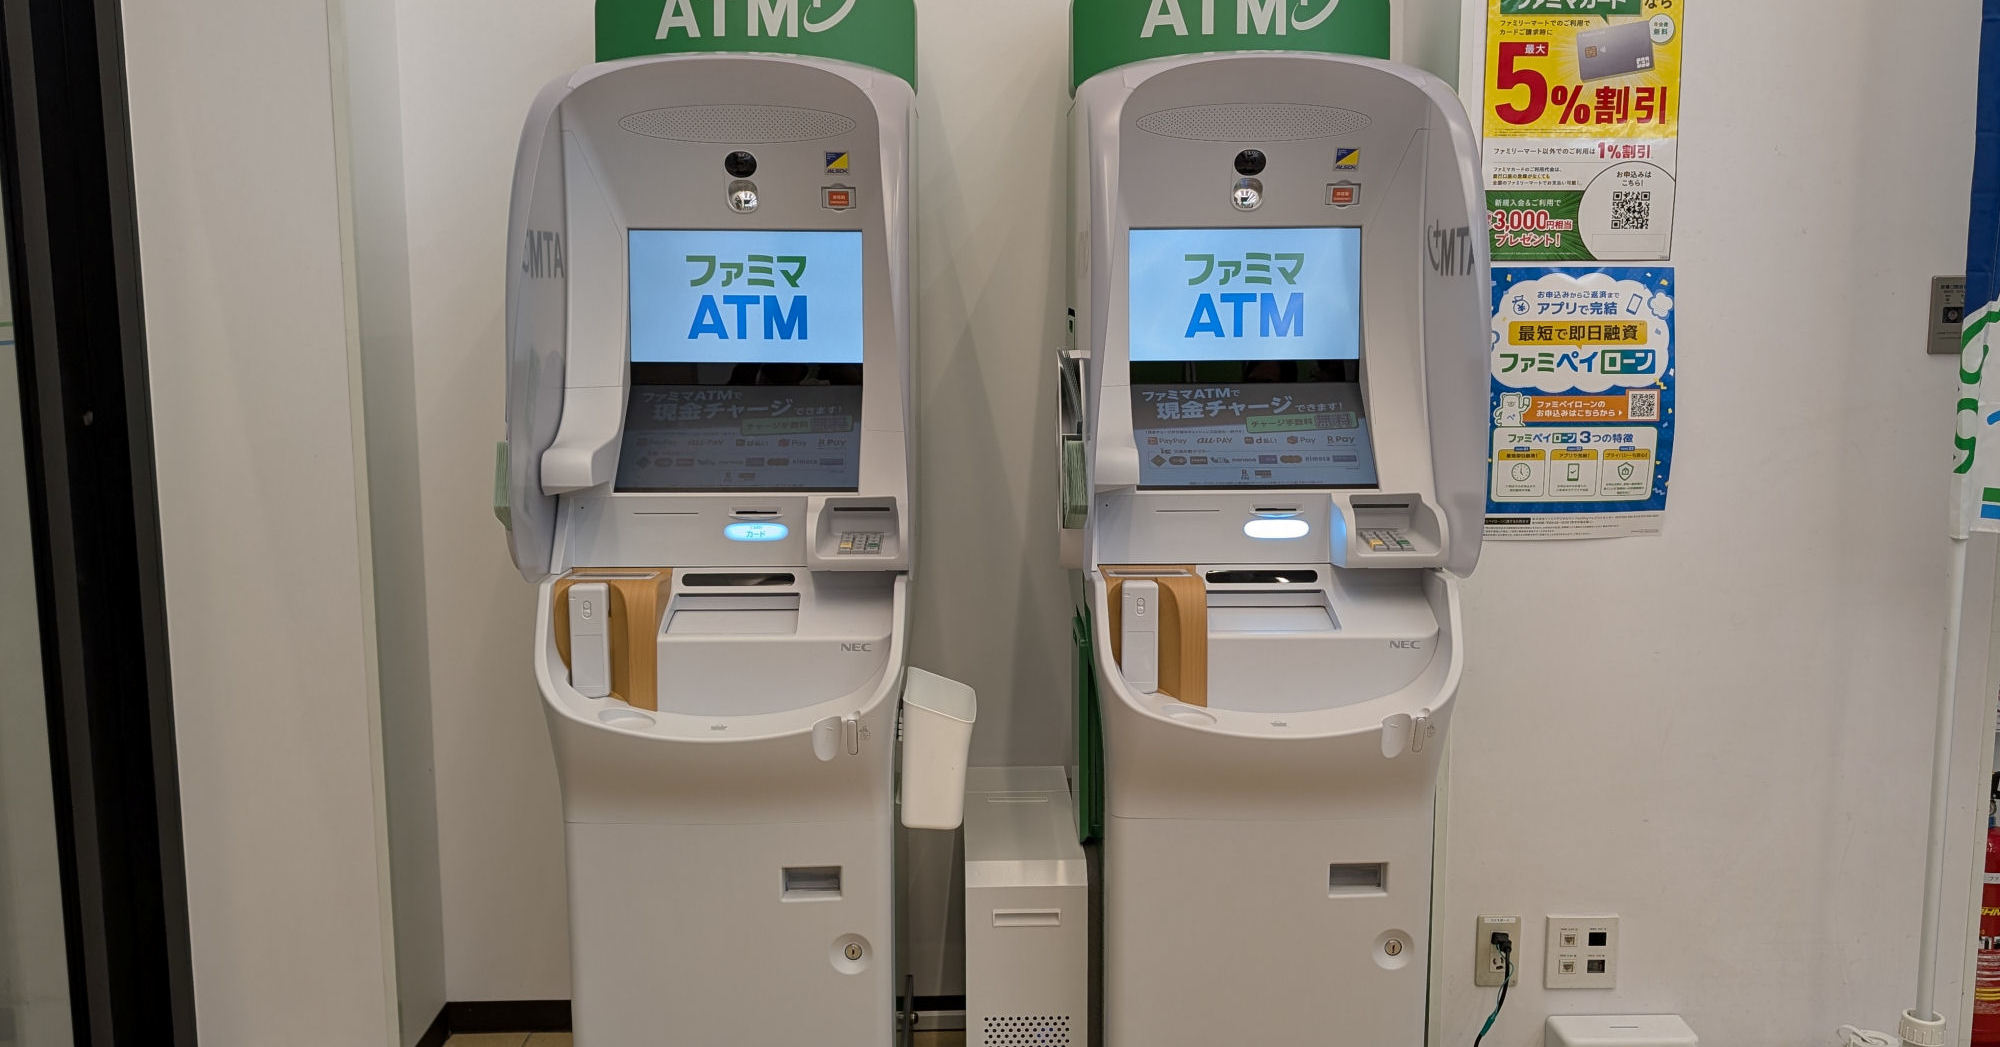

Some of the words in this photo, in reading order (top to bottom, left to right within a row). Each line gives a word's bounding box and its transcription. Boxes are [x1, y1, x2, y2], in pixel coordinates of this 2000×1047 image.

[1525, 44, 1546, 54] 最大
[1598, 141, 1651, 159] 1%割引
[1616, 171, 1651, 179] お申込みは
[1493, 209, 1573, 232] 3,000円相当
[1496, 233, 1561, 247] プレゼント!
[686, 254, 807, 288] ファミマ
[1184, 252, 1305, 286] ファミマ
[1537, 291, 1620, 299] お申込みからご返済まで
[1184, 292, 1304, 338] ATM
[1537, 301, 1618, 316] アプリで完結
[687, 294, 808, 340] ATM
[1518, 325, 1638, 342] 最短で即日融資
[1500, 351, 1655, 374] ファミペイローン
[1142, 387, 1240, 401] ファミマATMで
[1156, 395, 1292, 419] 現金チャージ
[1536, 410, 1616, 418] お申込みはこちらから
[1508, 433, 1577, 444] ファミペイローン
[1580, 430, 1634, 444] 3つの特徴
[840, 642, 872, 652] NEC
[1389, 640, 1420, 649] NEC
